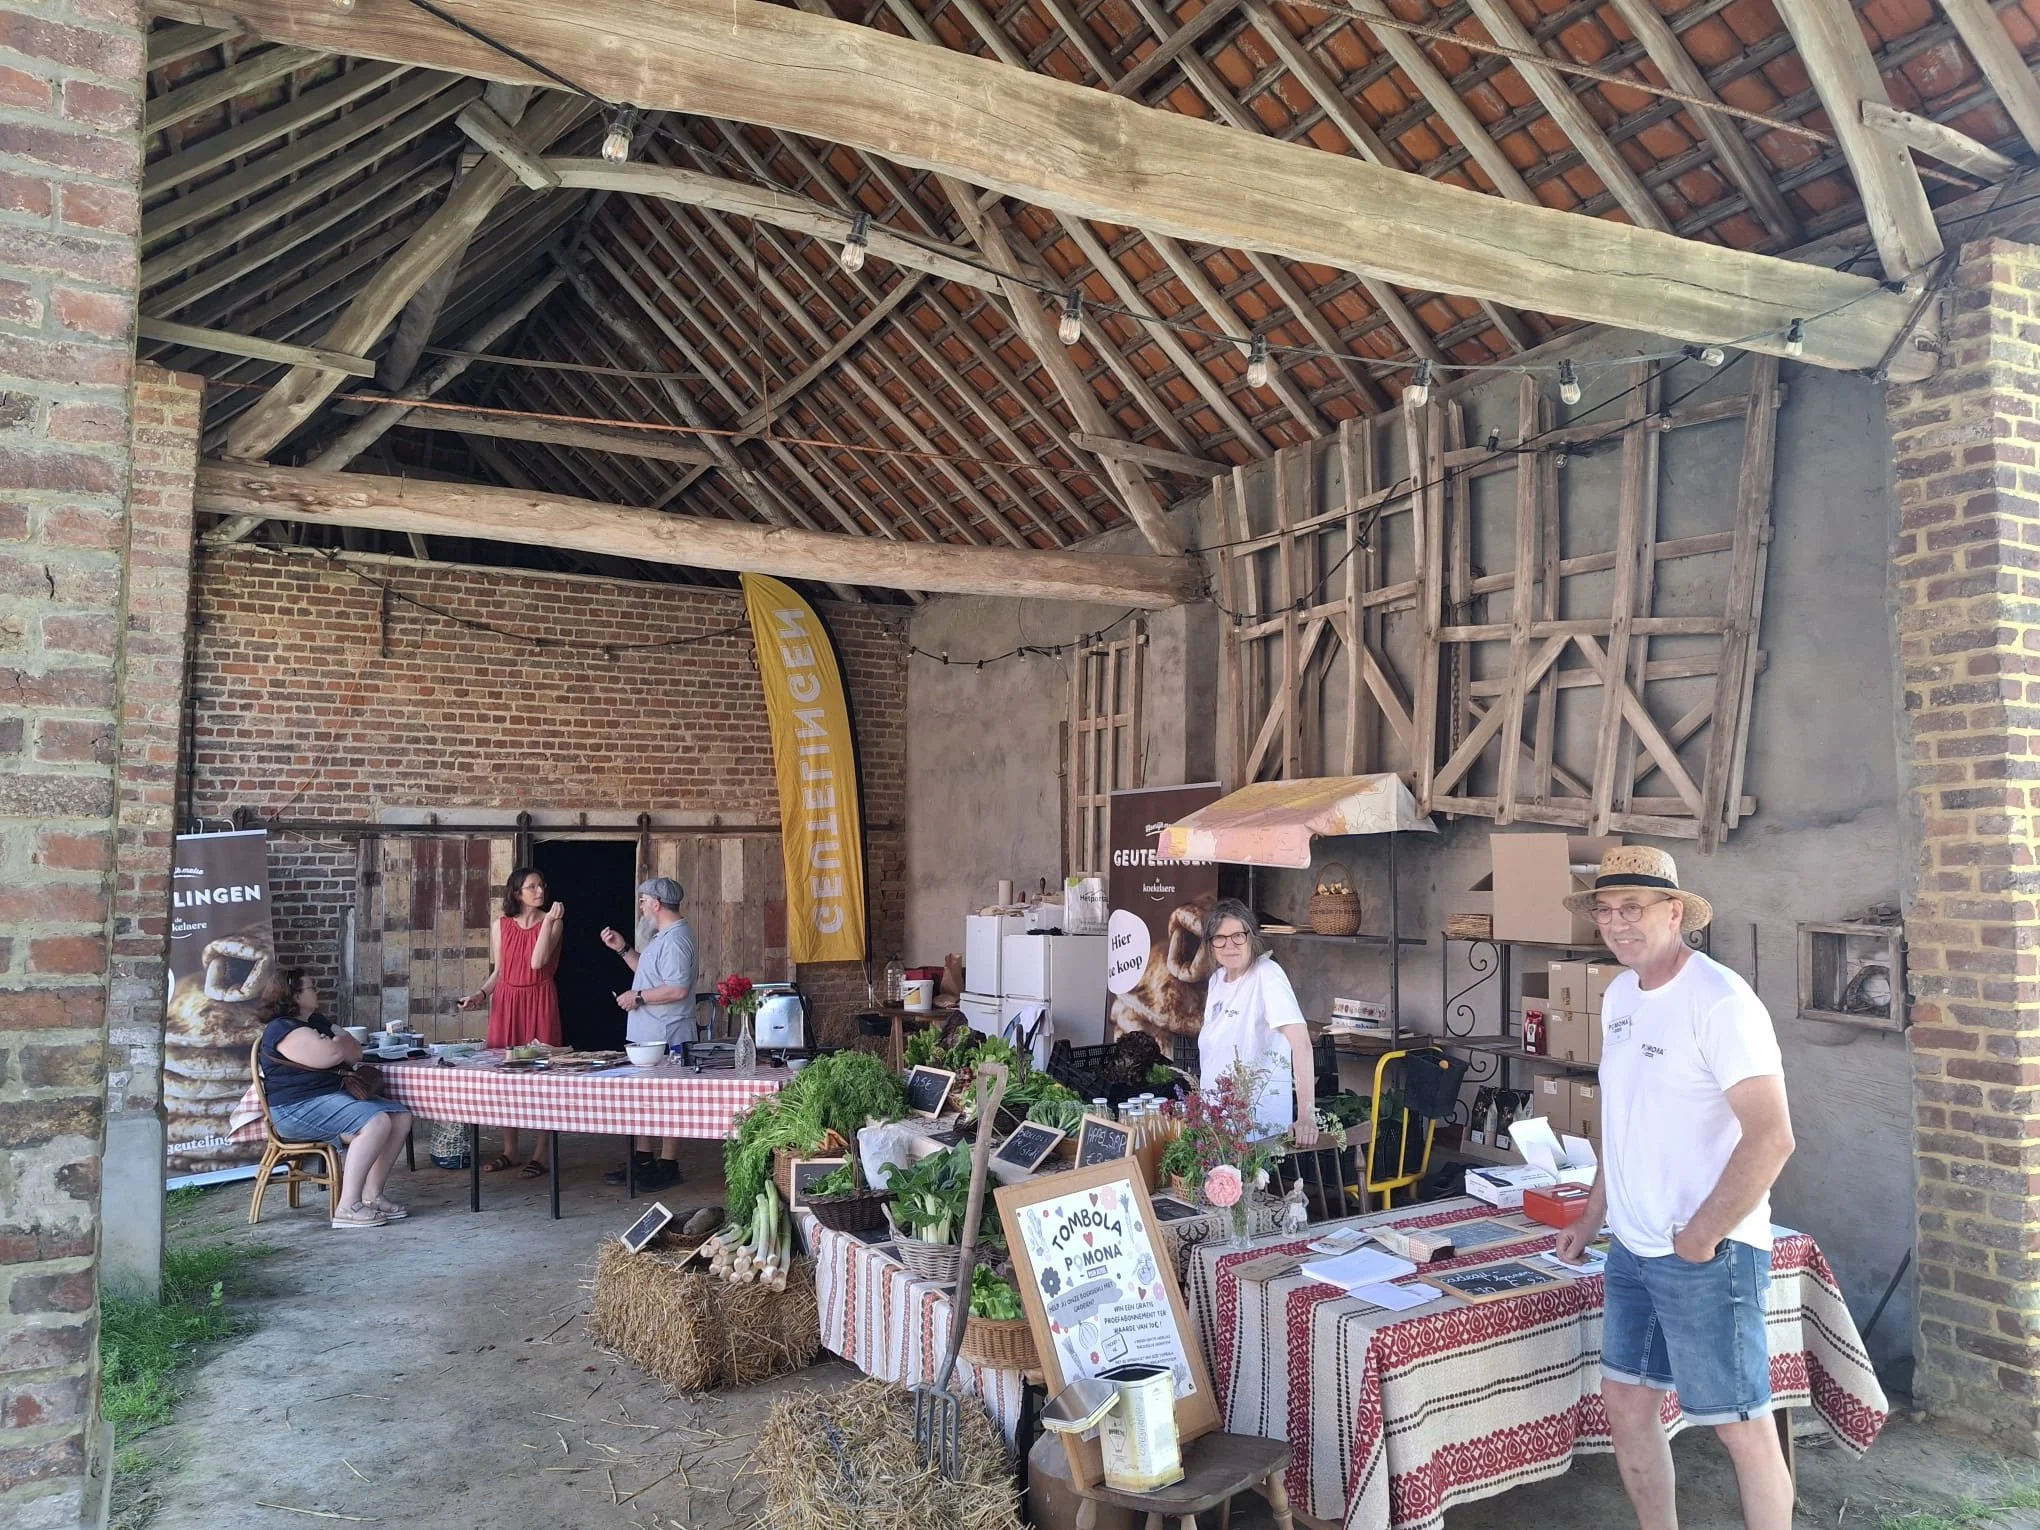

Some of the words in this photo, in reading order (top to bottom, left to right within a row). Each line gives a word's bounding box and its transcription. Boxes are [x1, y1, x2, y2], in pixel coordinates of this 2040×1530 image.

[173, 884, 261, 908] LINGEN
[1112, 933, 1131, 951] Hier
[1116, 955, 1142, 974] koop
[1052, 1208, 1122, 1251] TOMBOLA
[1064, 1243, 1123, 1272] POMONA
[1135, 1301, 1154, 1310] GRATIS
